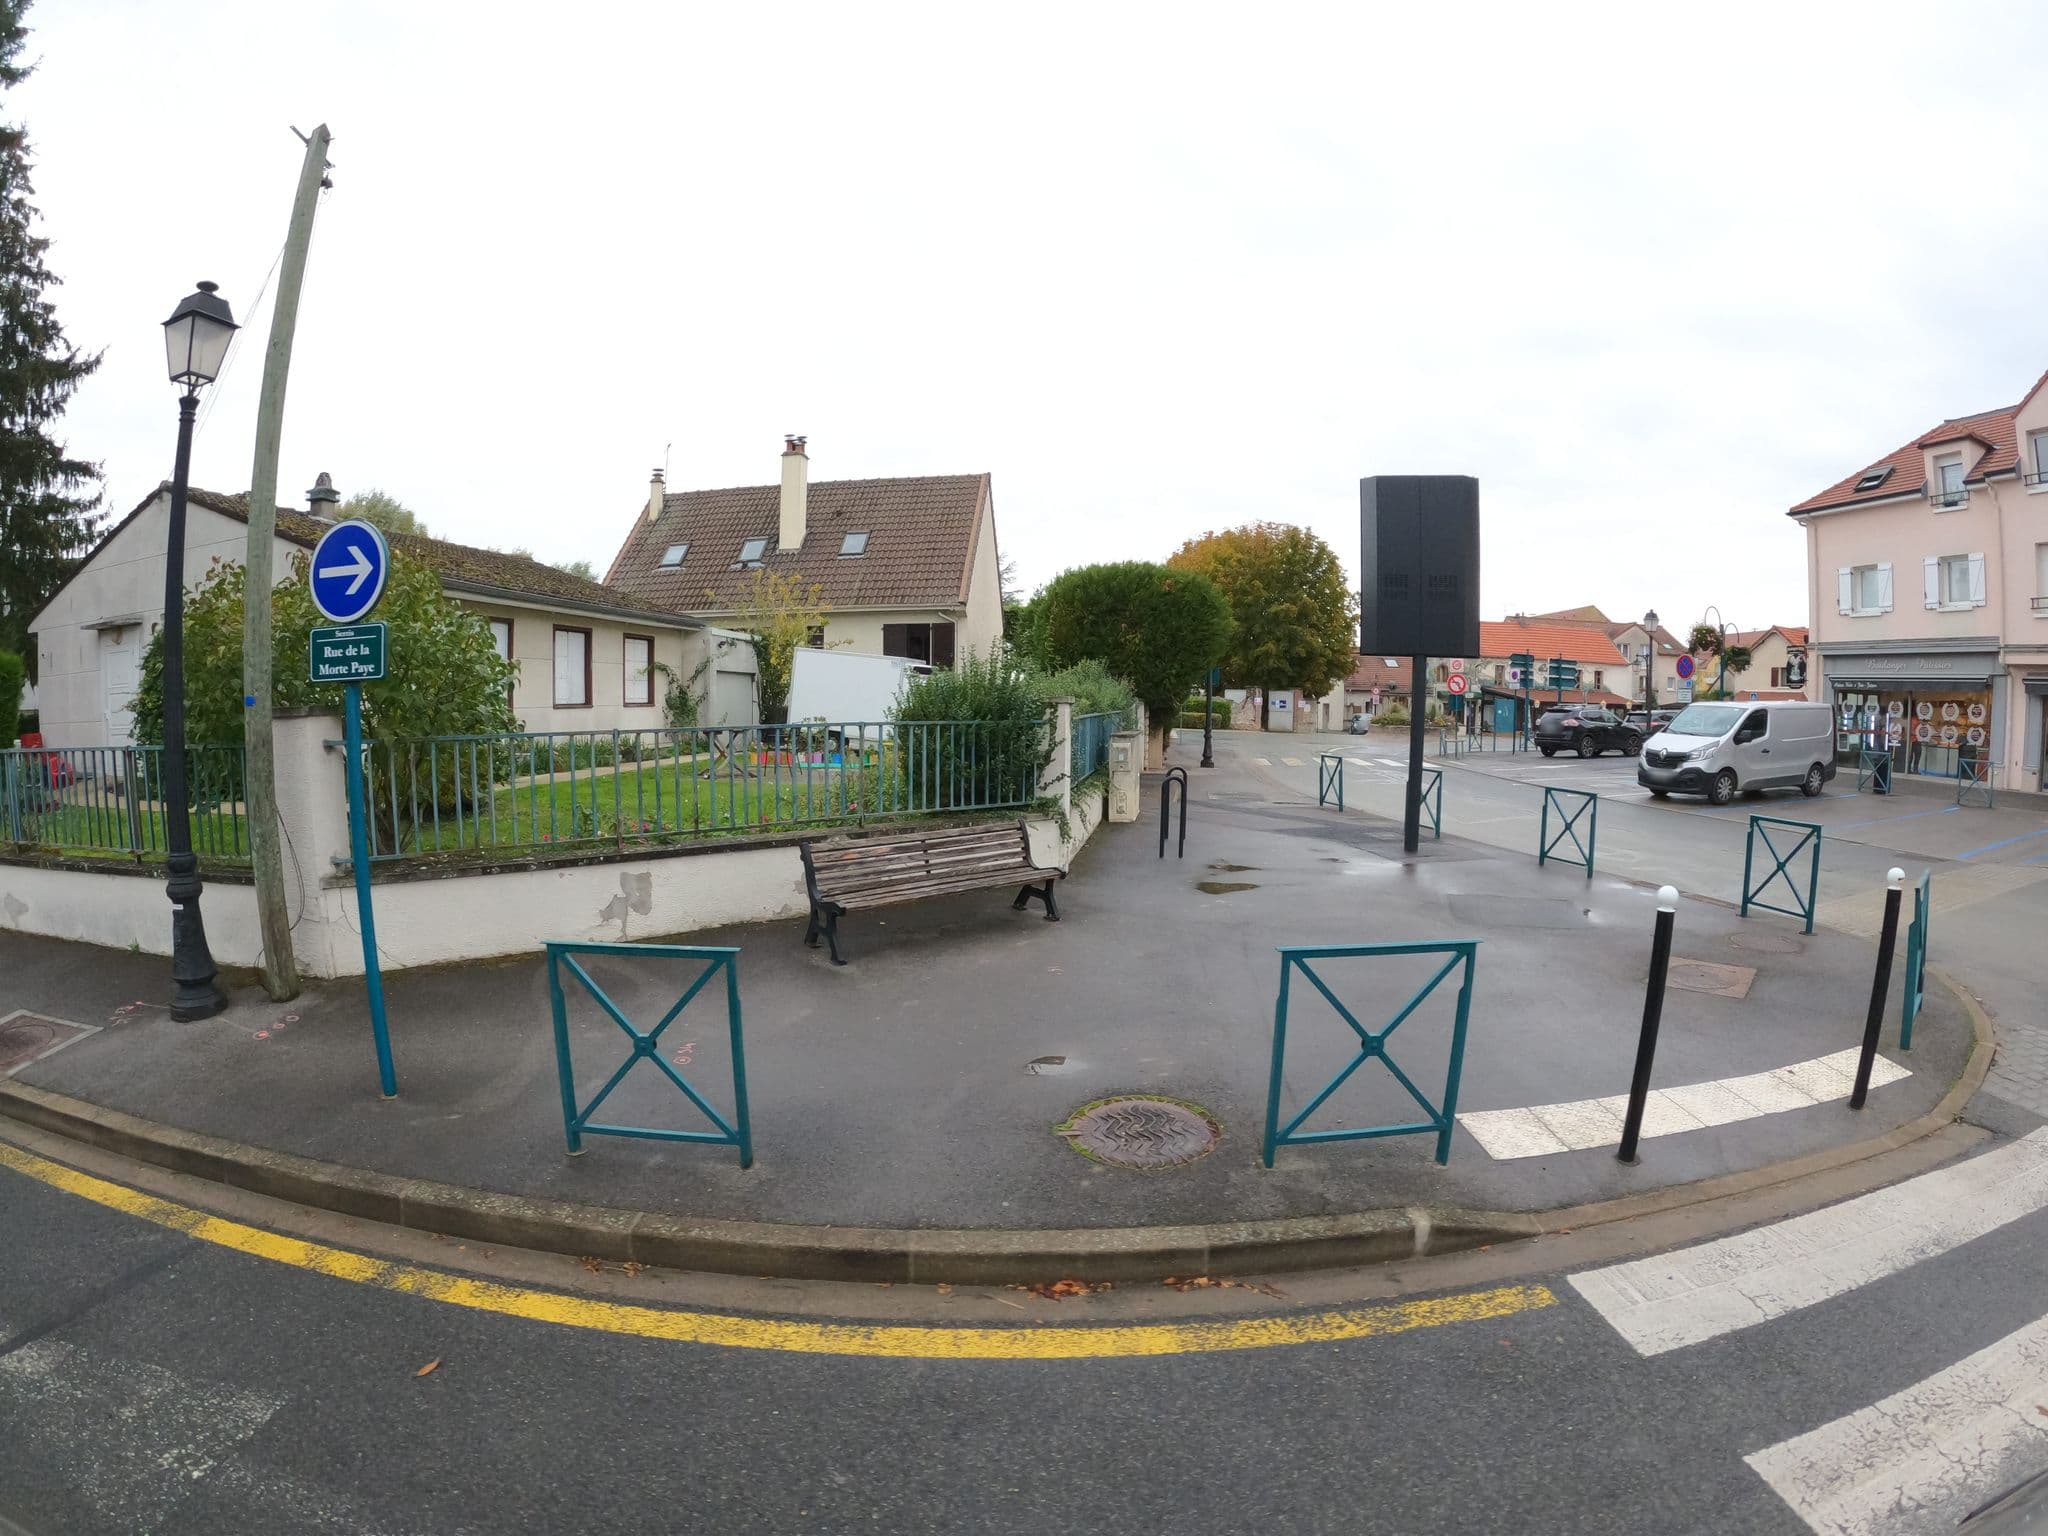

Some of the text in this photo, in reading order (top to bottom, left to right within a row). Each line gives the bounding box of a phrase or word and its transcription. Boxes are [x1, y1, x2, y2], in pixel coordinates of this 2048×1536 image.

[324, 644, 369, 657] Rue de la
[319, 661, 375, 676] Morte Paye
